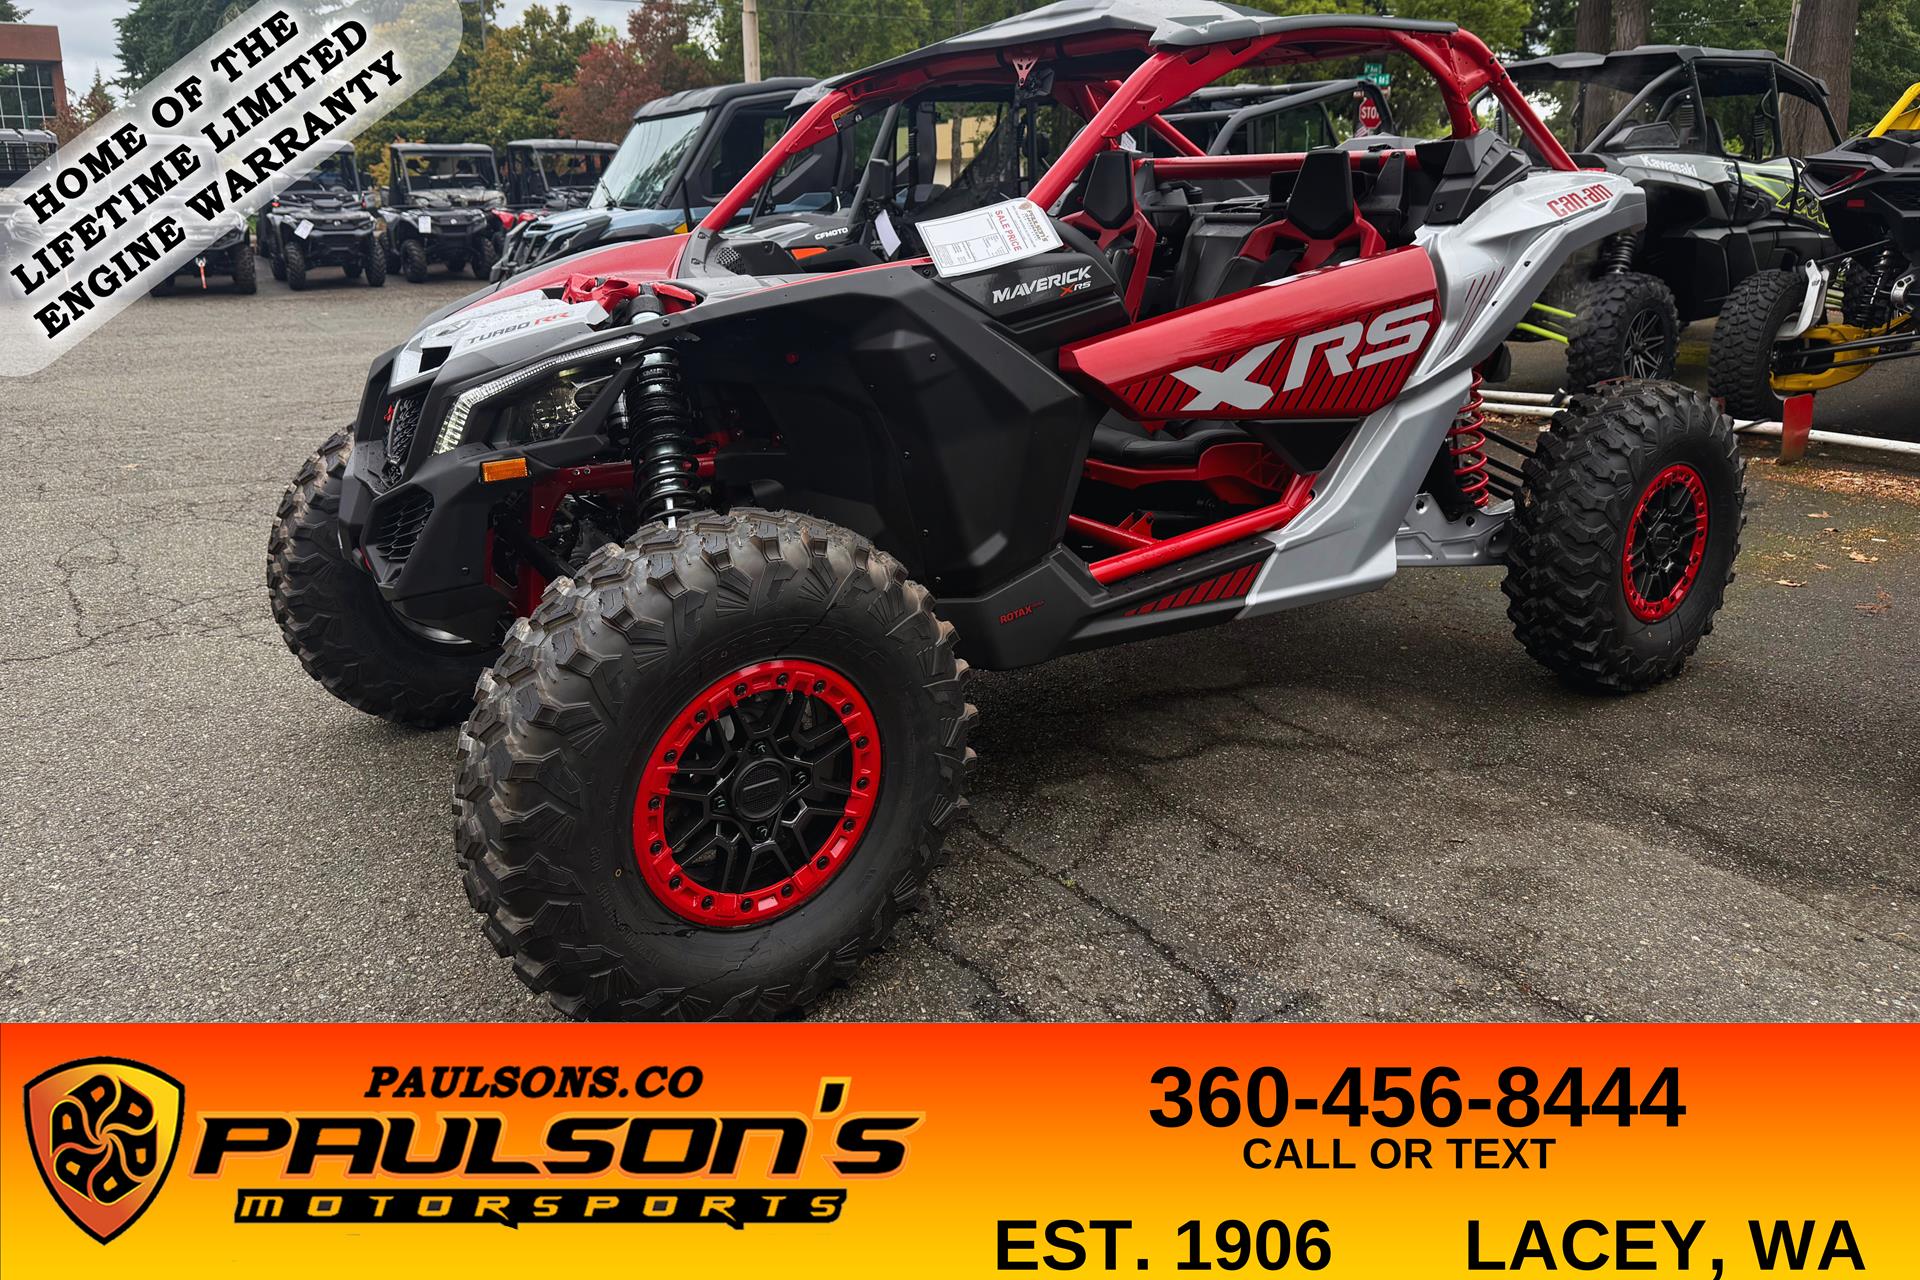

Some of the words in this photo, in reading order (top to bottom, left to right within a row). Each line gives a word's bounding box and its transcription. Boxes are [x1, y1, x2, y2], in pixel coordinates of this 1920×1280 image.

[1640, 155, 1698, 177] Kawasaki
[1547, 183, 1613, 218] can-am
[814, 226, 849, 241] CFMOTO
[995, 209, 1011, 230] SALE
[1006, 228, 1022, 252] PRICE
[992, 264, 1092, 304] MAVERICK
[1060, 280, 1092, 298] XRS
[467, 321, 531, 344] TURBO
[1169, 299, 1434, 412] XRS
[1000, 605, 1033, 624] ROTAX
